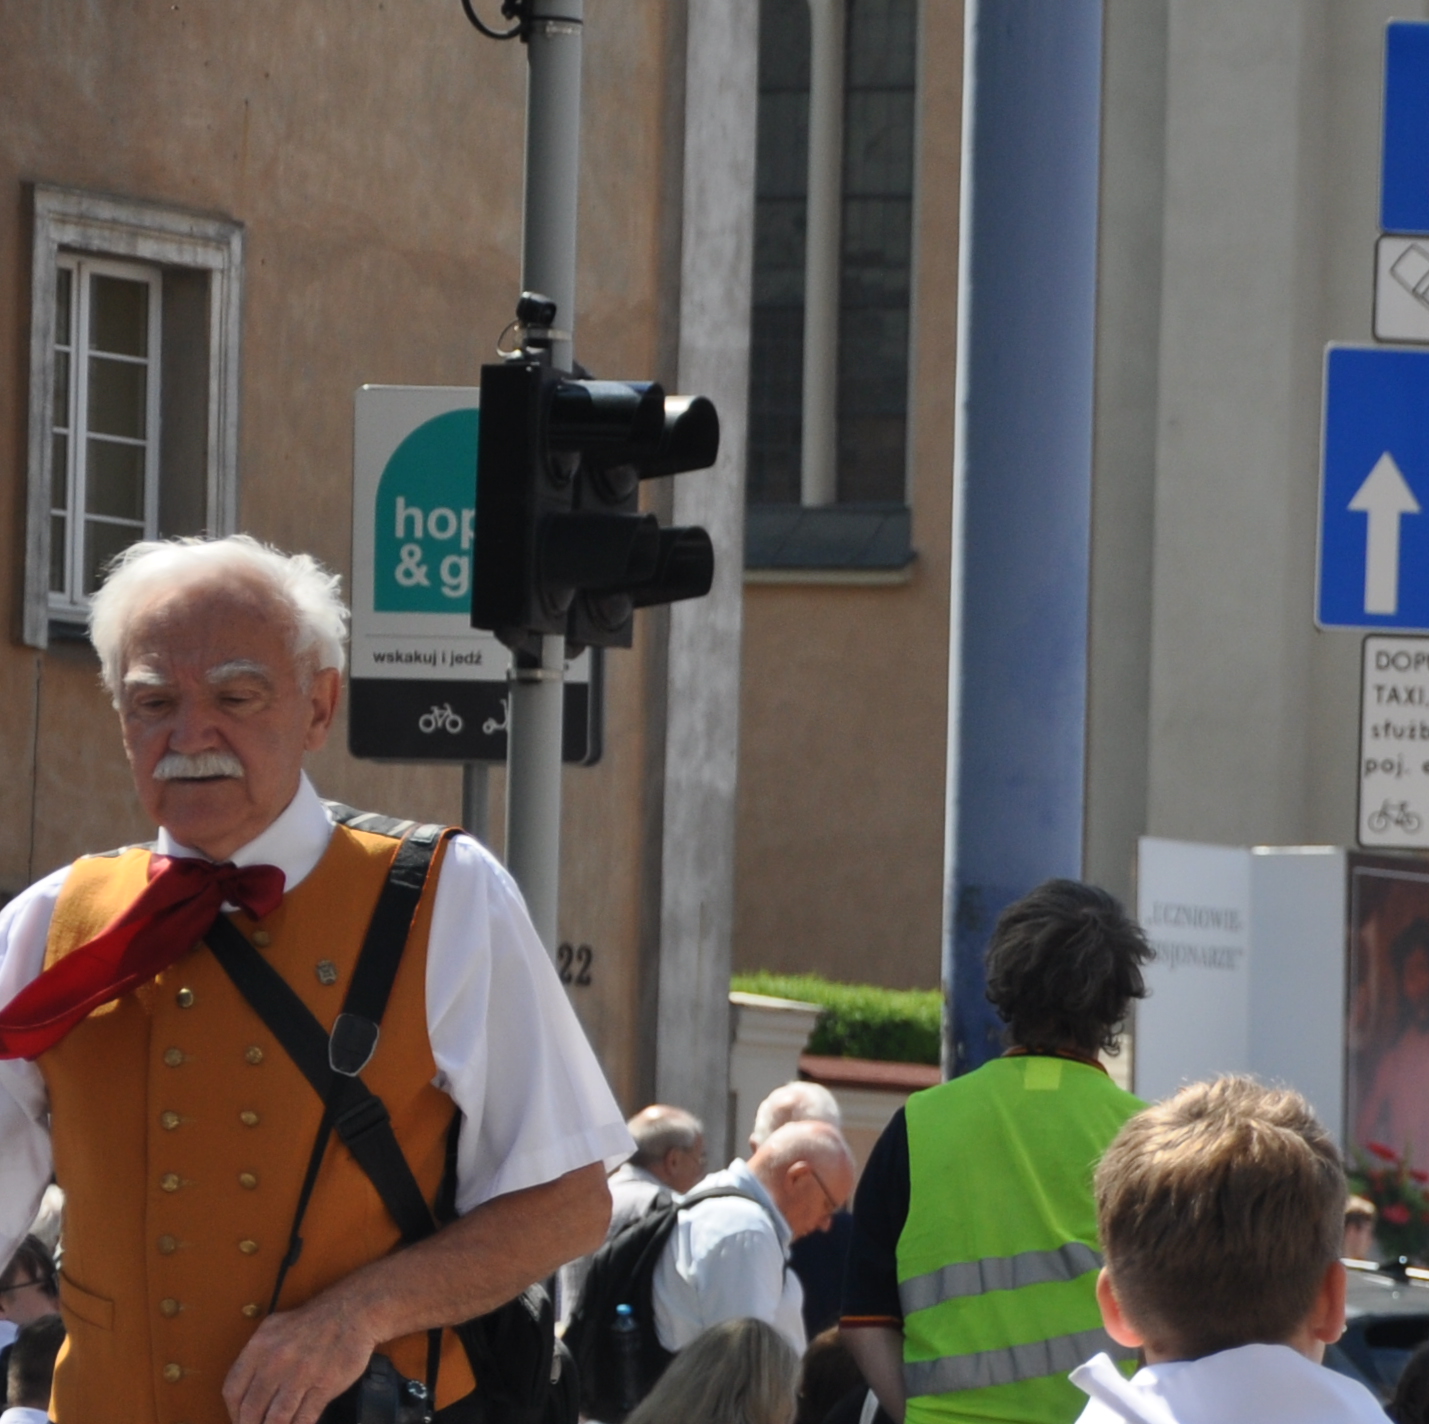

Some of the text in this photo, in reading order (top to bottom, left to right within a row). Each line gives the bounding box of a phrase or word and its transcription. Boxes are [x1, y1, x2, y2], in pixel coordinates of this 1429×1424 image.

[395, 543, 431, 588] &
[372, 650, 483, 667] wskakuj i jedź
[1364, 753, 1410, 781] poj.
[557, 942, 593, 986] 22
